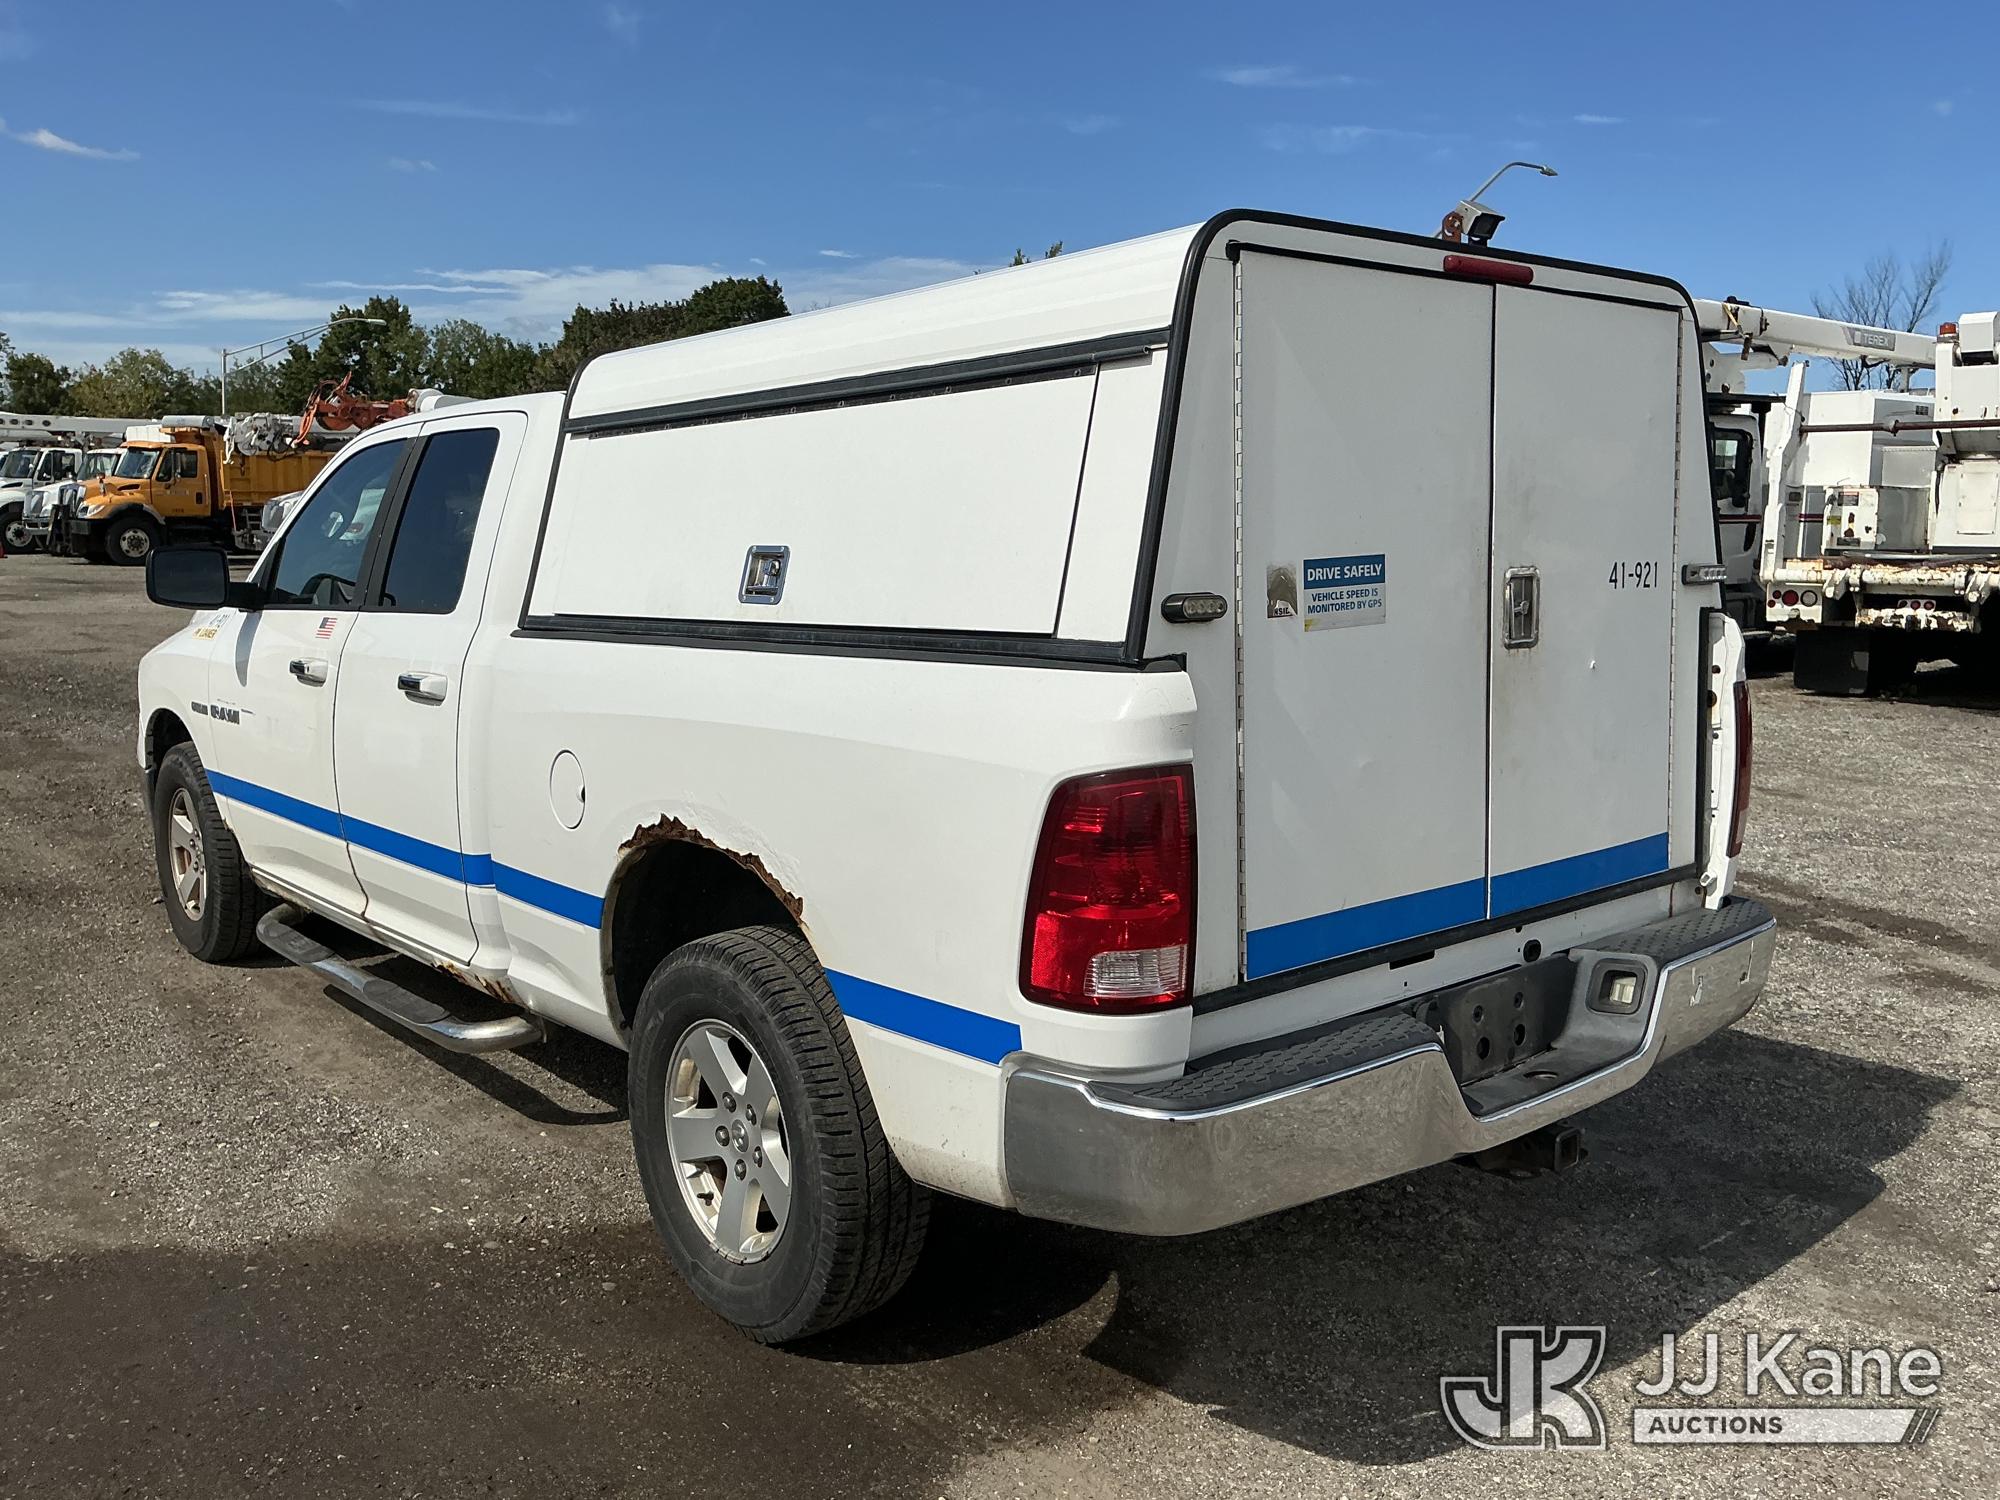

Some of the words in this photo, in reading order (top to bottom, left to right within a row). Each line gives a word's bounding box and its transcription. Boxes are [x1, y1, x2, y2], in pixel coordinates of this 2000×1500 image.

[1863, 333, 1889, 347] TEREX
[1308, 567, 1341, 581] DRIVE
[1343, 563, 1382, 578] SAFELY
[1608, 561, 1658, 589] 41-921
[1312, 591, 1344, 602] VEHICLE
[1346, 588, 1370, 600] SPEED
[1371, 588, 1378, 597] IS
[1307, 603, 1355, 614] MONITORED
[1357, 601, 1366, 609] BY
[1368, 598, 1382, 608] GPS
